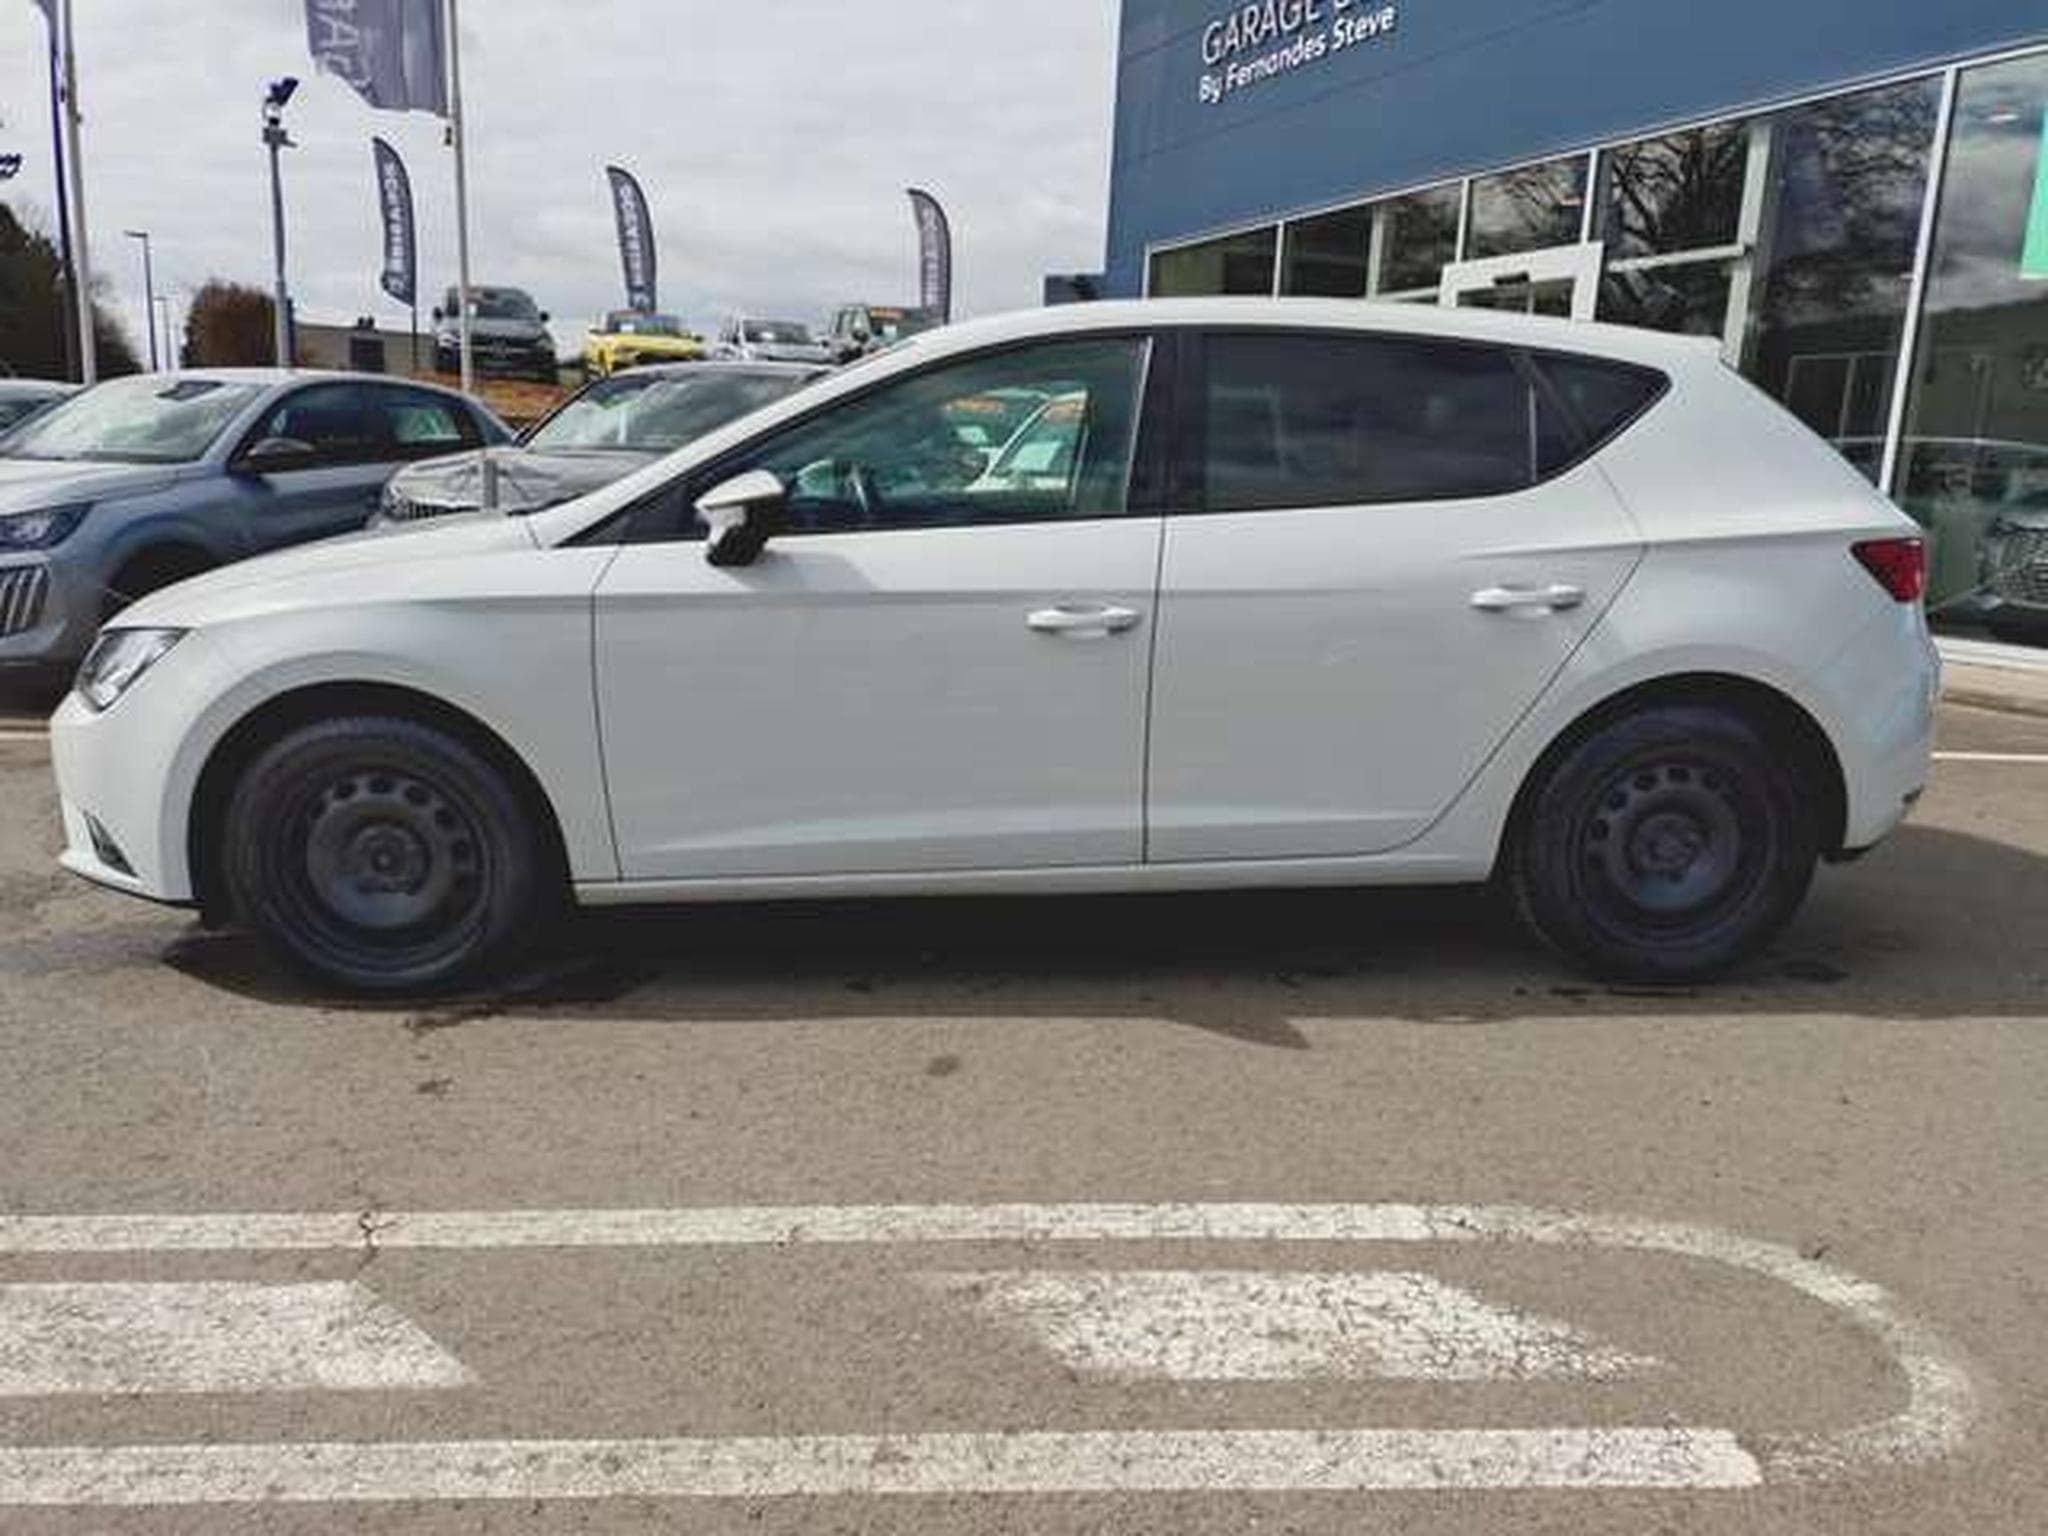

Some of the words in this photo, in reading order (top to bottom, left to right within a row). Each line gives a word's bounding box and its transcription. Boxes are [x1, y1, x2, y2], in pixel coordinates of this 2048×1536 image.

[1199, 75, 1222, 103] By
[1226, 34, 1326, 89] Fernandes
[1332, 7, 1395, 49] Steve
